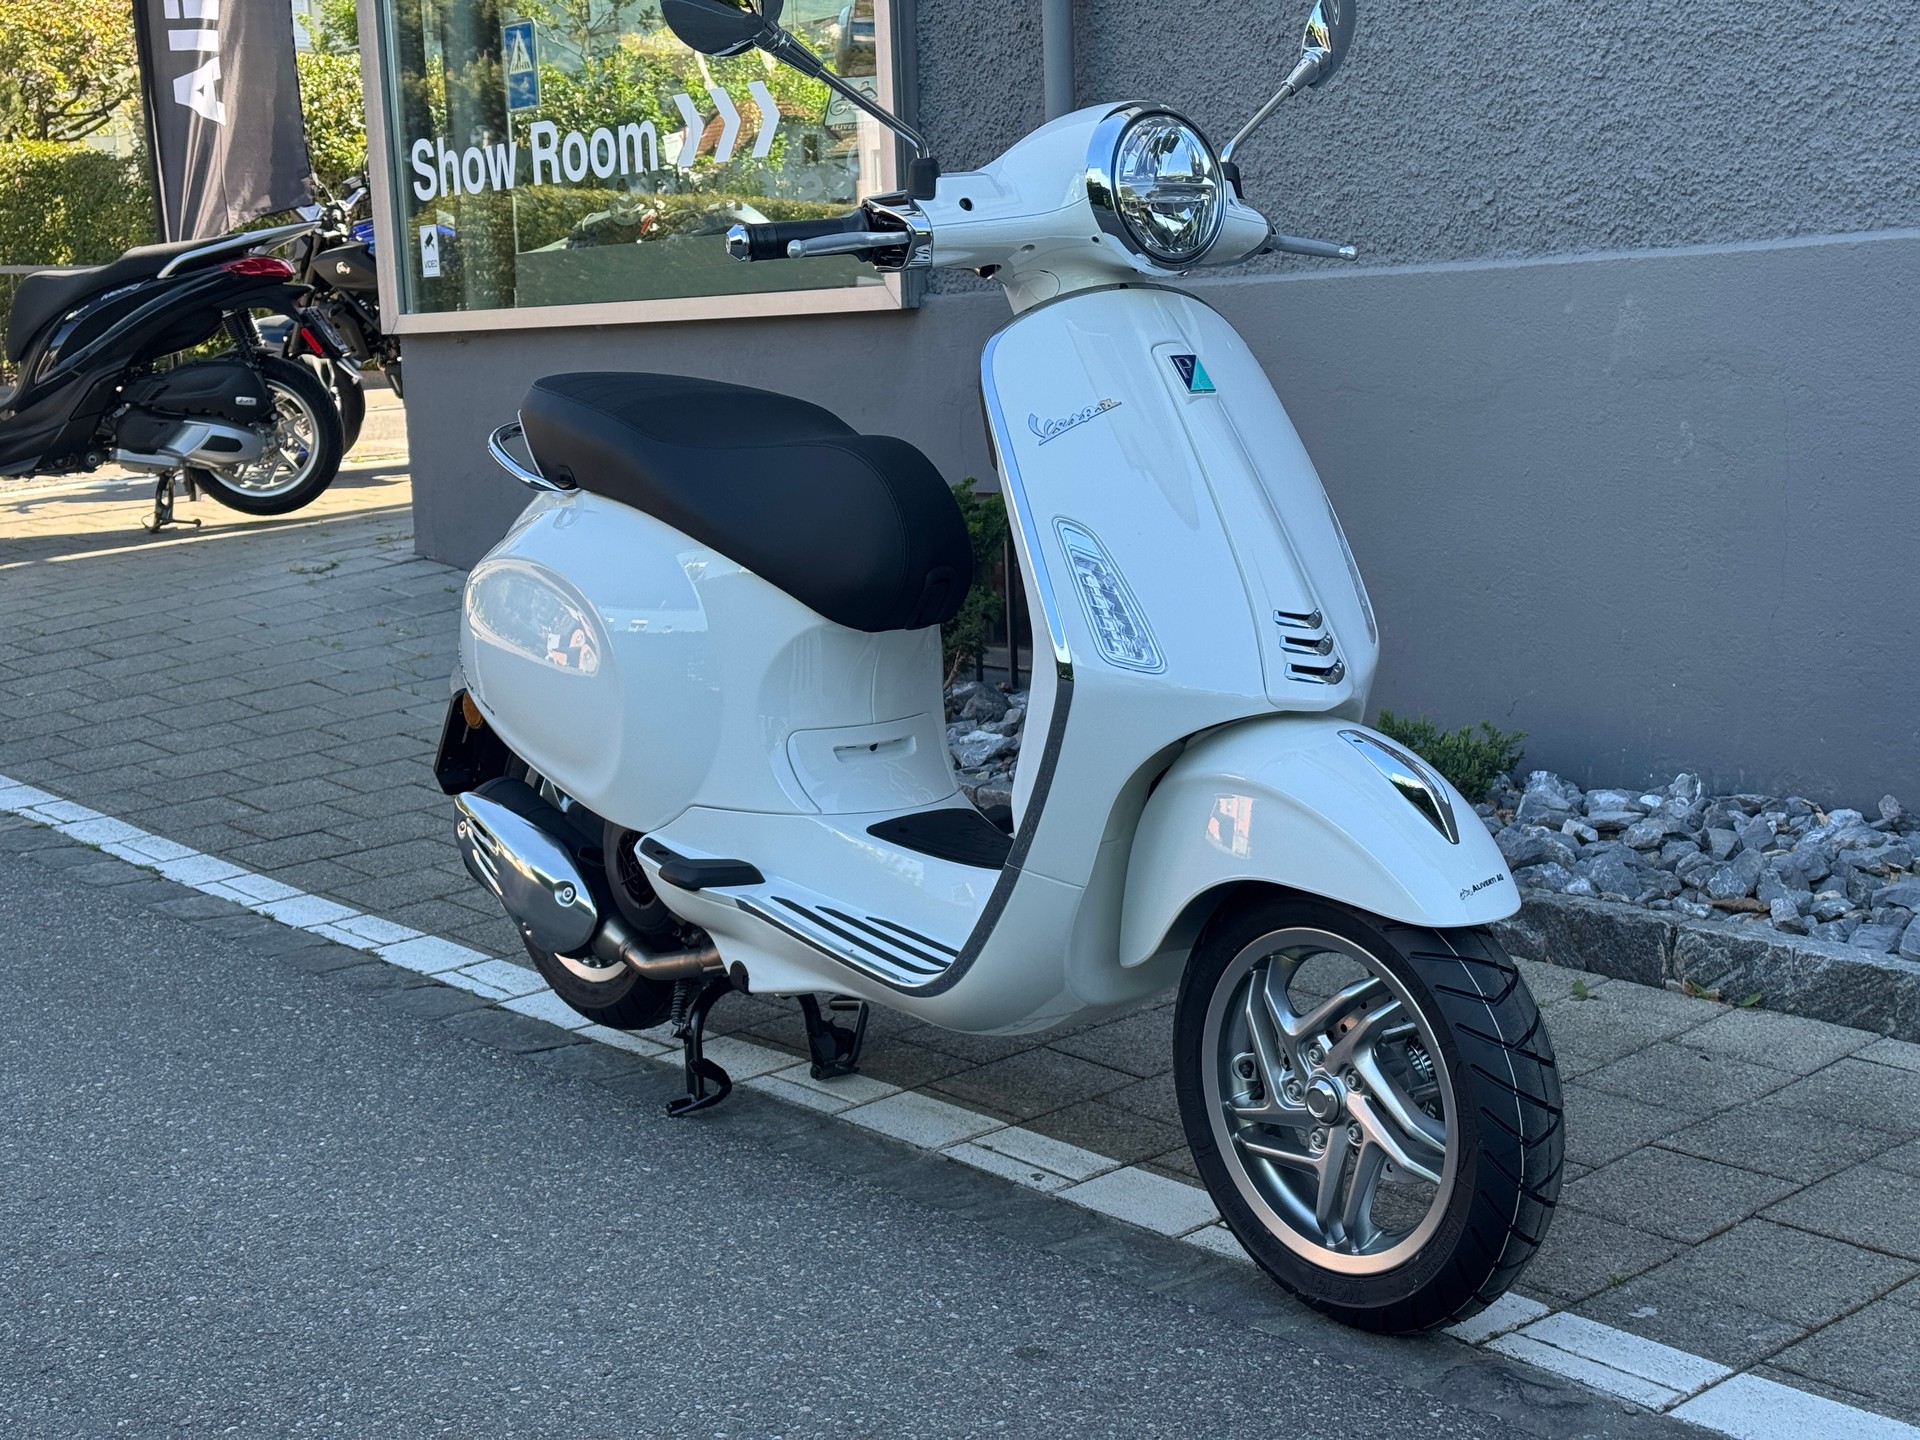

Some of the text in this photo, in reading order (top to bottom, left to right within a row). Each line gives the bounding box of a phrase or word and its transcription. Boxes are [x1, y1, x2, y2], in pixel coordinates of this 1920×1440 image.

[411, 136, 518, 201] Show
[529, 119, 660, 187] Room
[1027, 398, 1122, 446] Vespa
